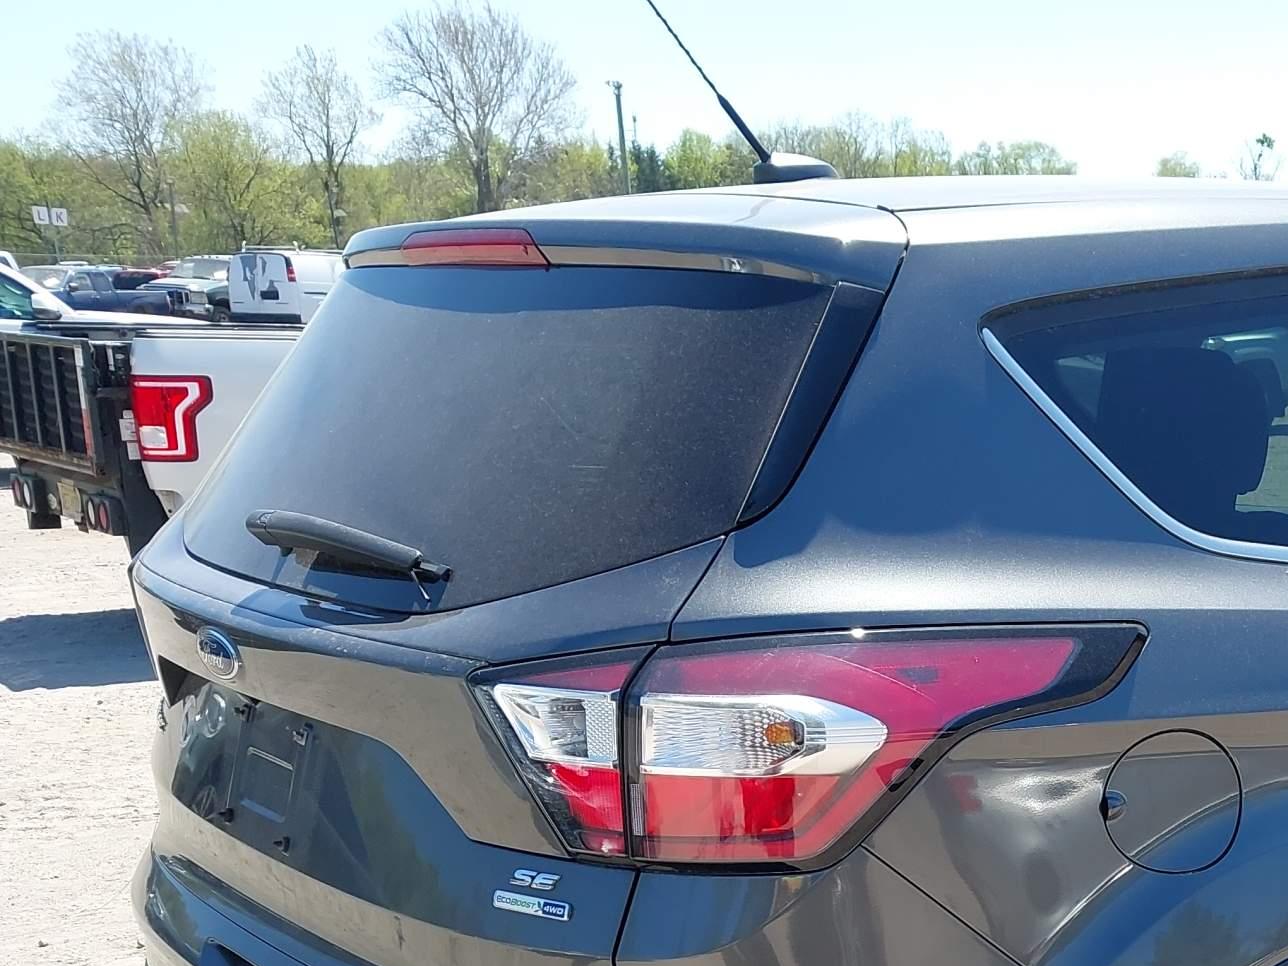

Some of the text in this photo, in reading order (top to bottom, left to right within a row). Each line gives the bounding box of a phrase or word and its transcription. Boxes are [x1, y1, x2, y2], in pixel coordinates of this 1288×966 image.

[37, 209, 46, 221] L
[55, 211, 65, 224] K
[509, 869, 561, 890] SE
[543, 905, 564, 915] 4WD
